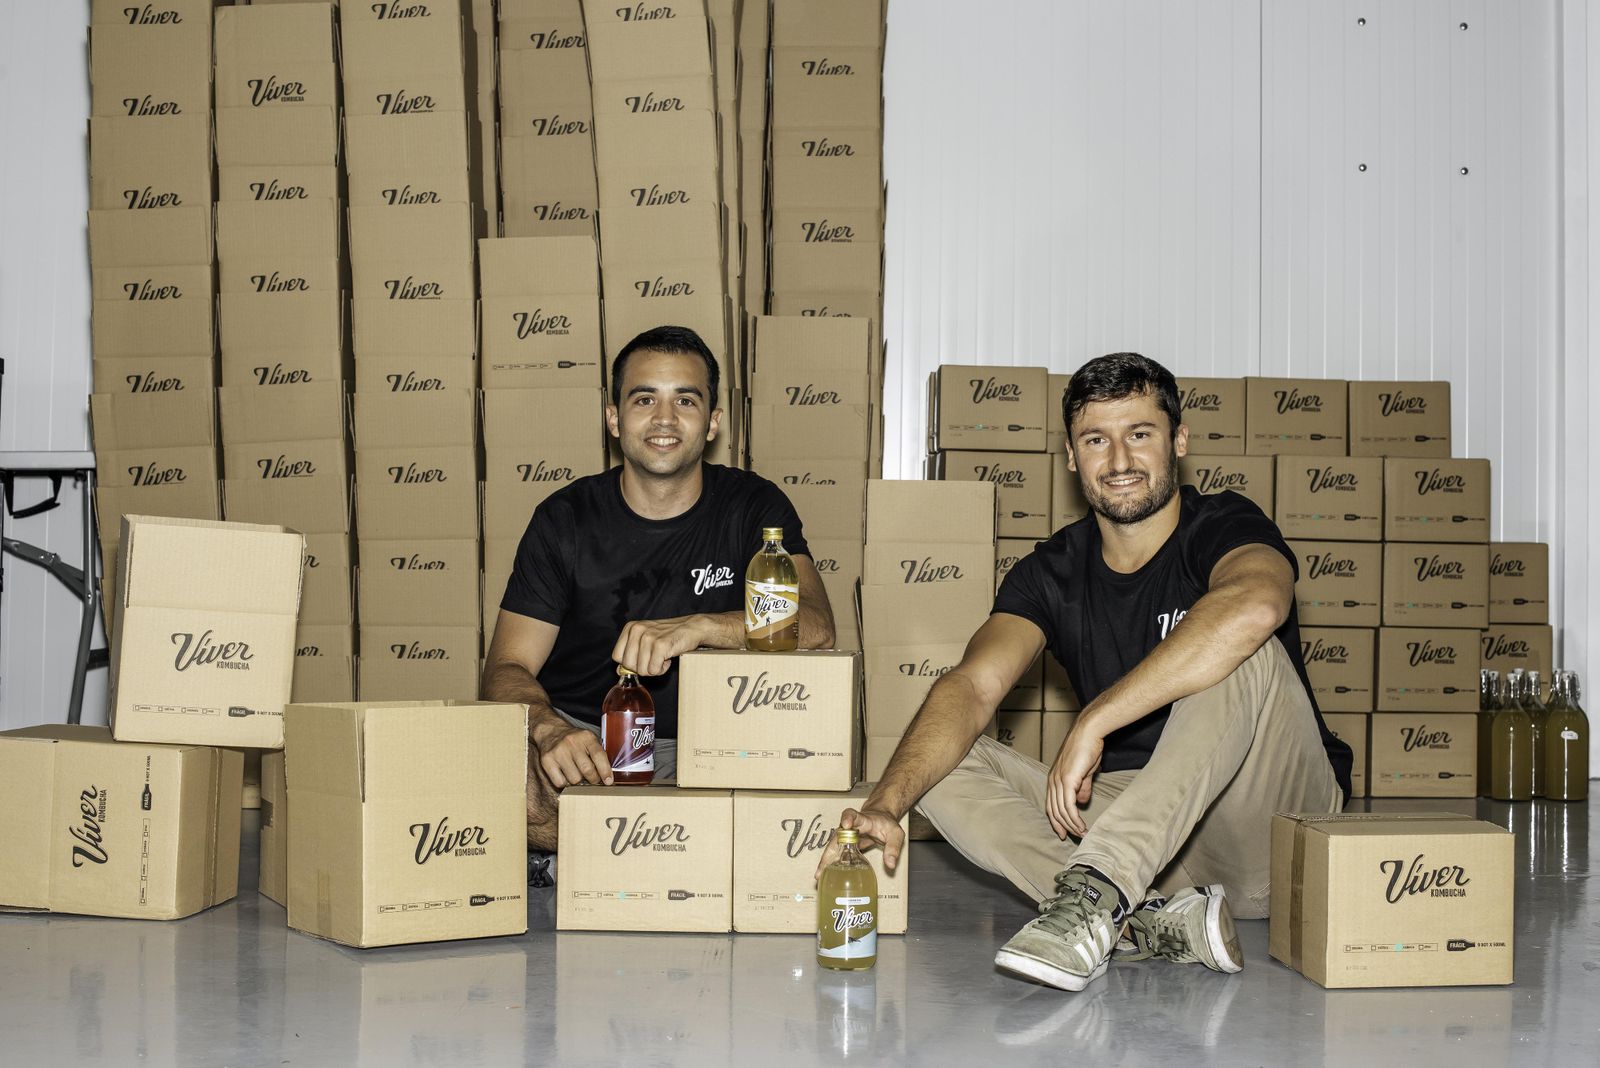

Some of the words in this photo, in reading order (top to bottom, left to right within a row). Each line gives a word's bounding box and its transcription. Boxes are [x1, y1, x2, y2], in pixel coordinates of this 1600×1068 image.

[216, 662, 249, 670] KOMBUCHA
[774, 703, 807, 711] KOMBUCHA
[98, 789, 107, 822] KOMBUCHA
[653, 844, 686, 852] KOMBUCHA
[455, 848, 486, 857] KOMBUCHA
[1431, 888, 1466, 897] KOMBUCHA
